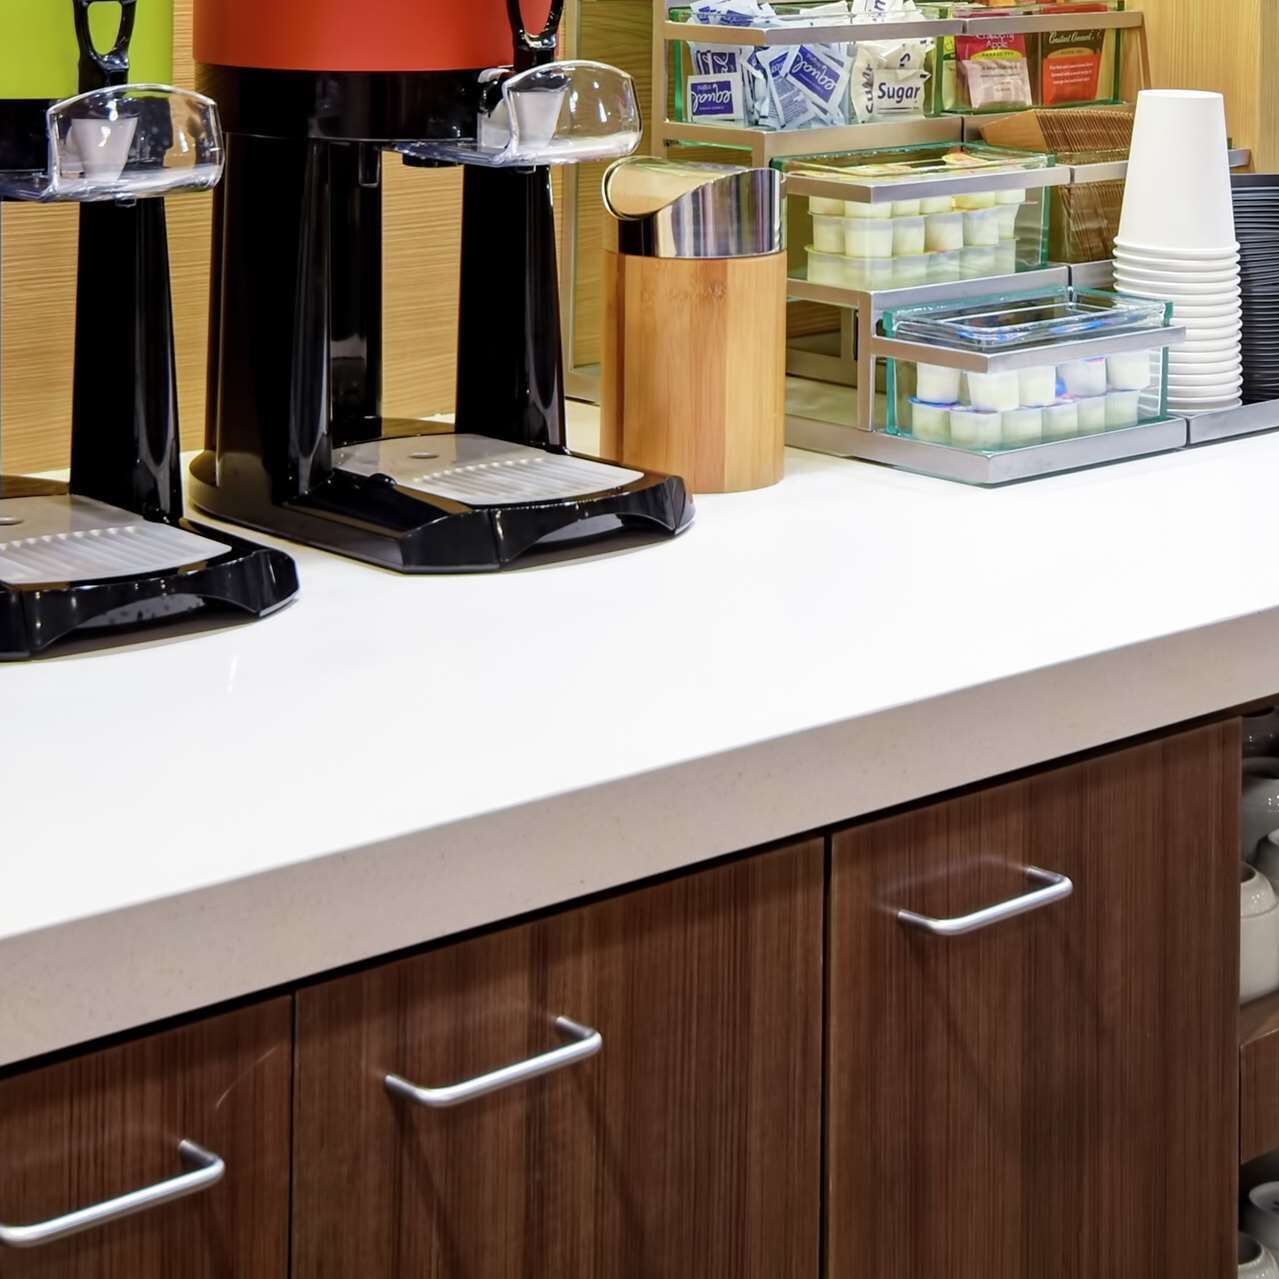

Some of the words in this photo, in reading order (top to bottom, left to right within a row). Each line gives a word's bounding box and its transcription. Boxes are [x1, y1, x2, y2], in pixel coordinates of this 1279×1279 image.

[790, 51, 837, 91] equal
[691, 83, 734, 111] equal
[877, 82, 920, 104] Sugar
